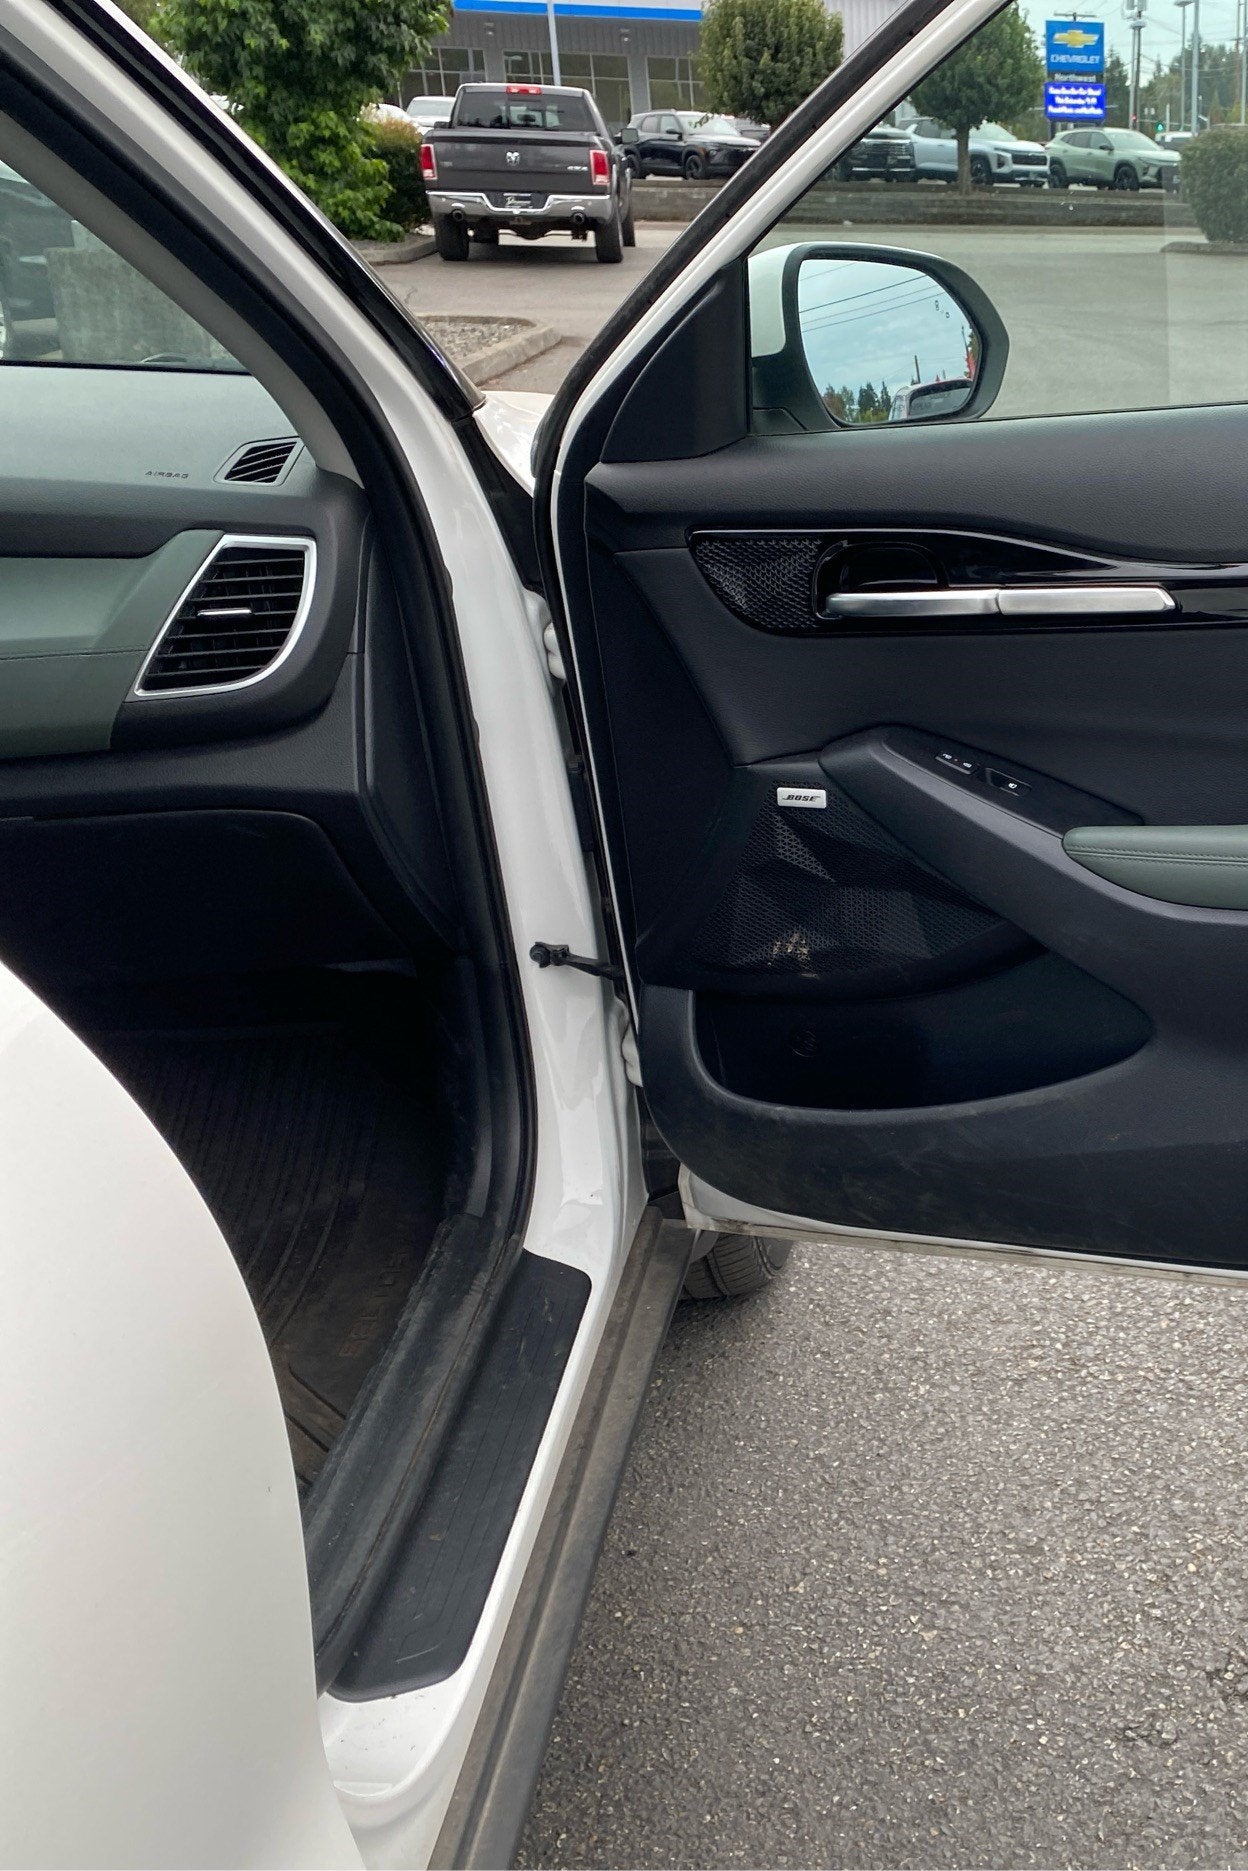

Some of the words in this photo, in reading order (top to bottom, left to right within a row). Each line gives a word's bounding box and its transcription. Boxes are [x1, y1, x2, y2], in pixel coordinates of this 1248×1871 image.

[1050, 54, 1100, 64] CHEVROLET
[144, 470, 189, 479] AIRBAG
[782, 794, 821, 802] BOSE
